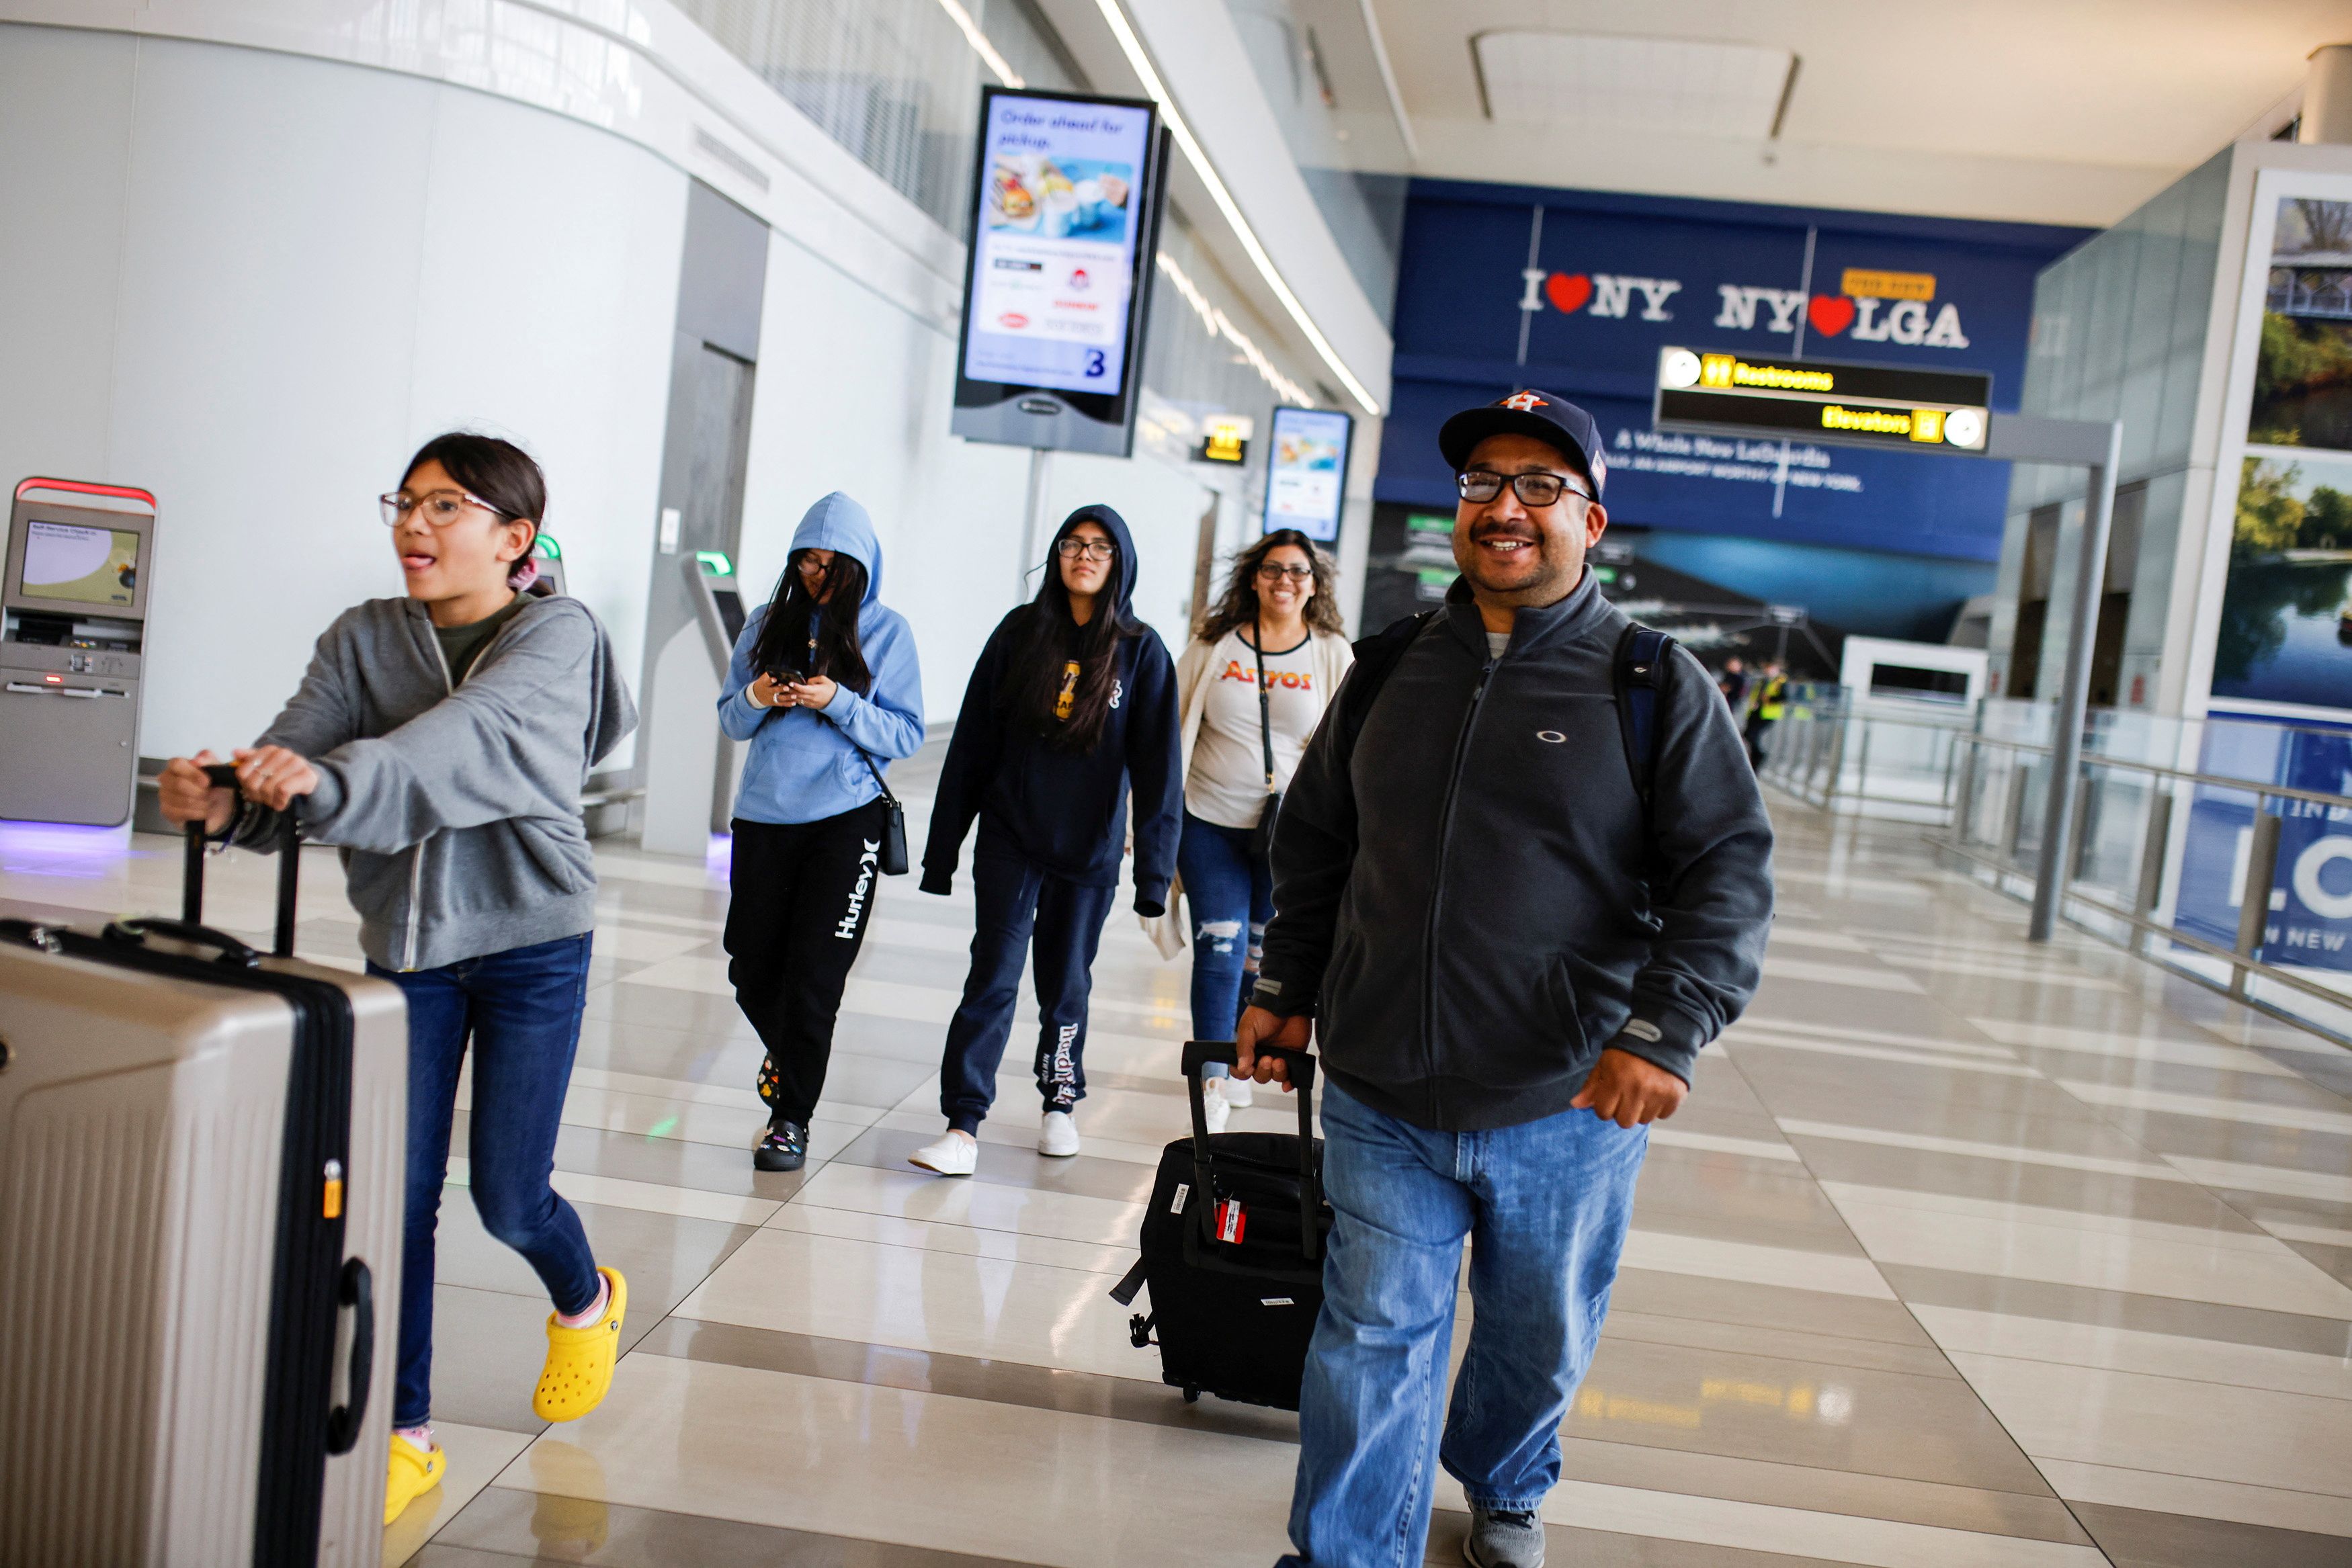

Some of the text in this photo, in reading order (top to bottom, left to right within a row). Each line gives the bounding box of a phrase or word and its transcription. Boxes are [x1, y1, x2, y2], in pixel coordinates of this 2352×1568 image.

[1519, 269, 1683, 322] I NY
[1714, 284, 1970, 349] NY LGA
[1085, 348, 1105, 378] 3
[1734, 362, 1835, 392] Restrooms
[1822, 405, 1911, 435] Elevators
[1221, 660, 1312, 691] Asros
[835, 865, 873, 939] Hurley
[2286, 928, 2347, 952] NEW
